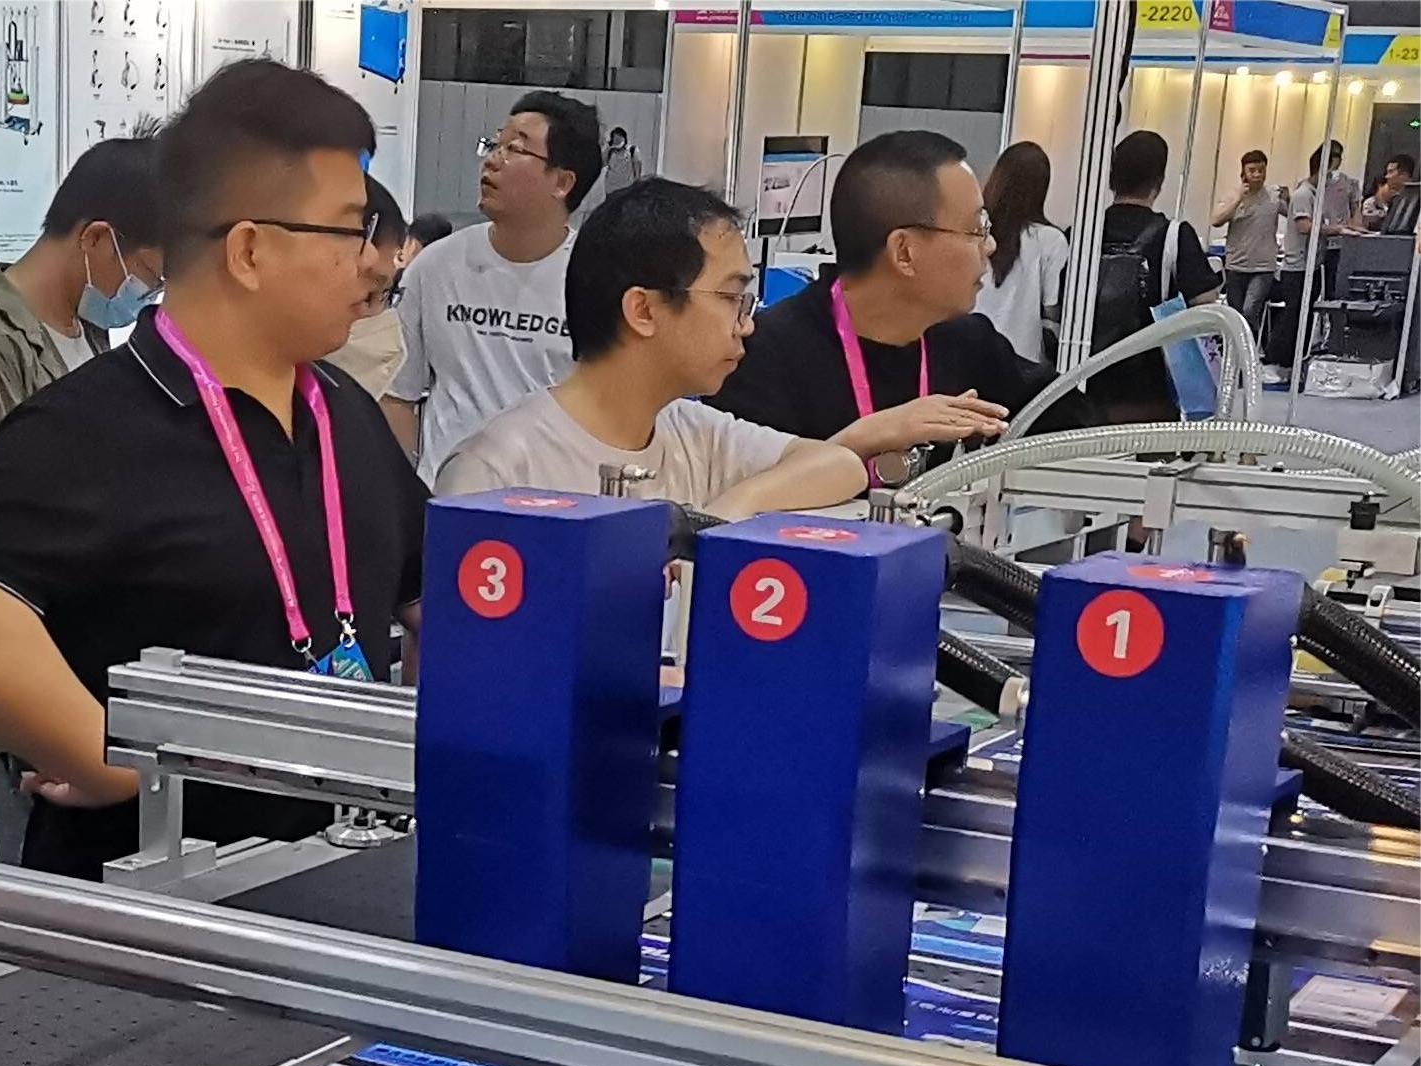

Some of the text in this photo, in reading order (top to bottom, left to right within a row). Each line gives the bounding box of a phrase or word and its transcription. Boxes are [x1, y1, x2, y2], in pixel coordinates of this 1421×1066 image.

[1141, 6, 1193, 22] -2220
[477, 556, 507, 603] 3
[751, 577, 785, 626] 2
[1104, 608, 1133, 660] 1
